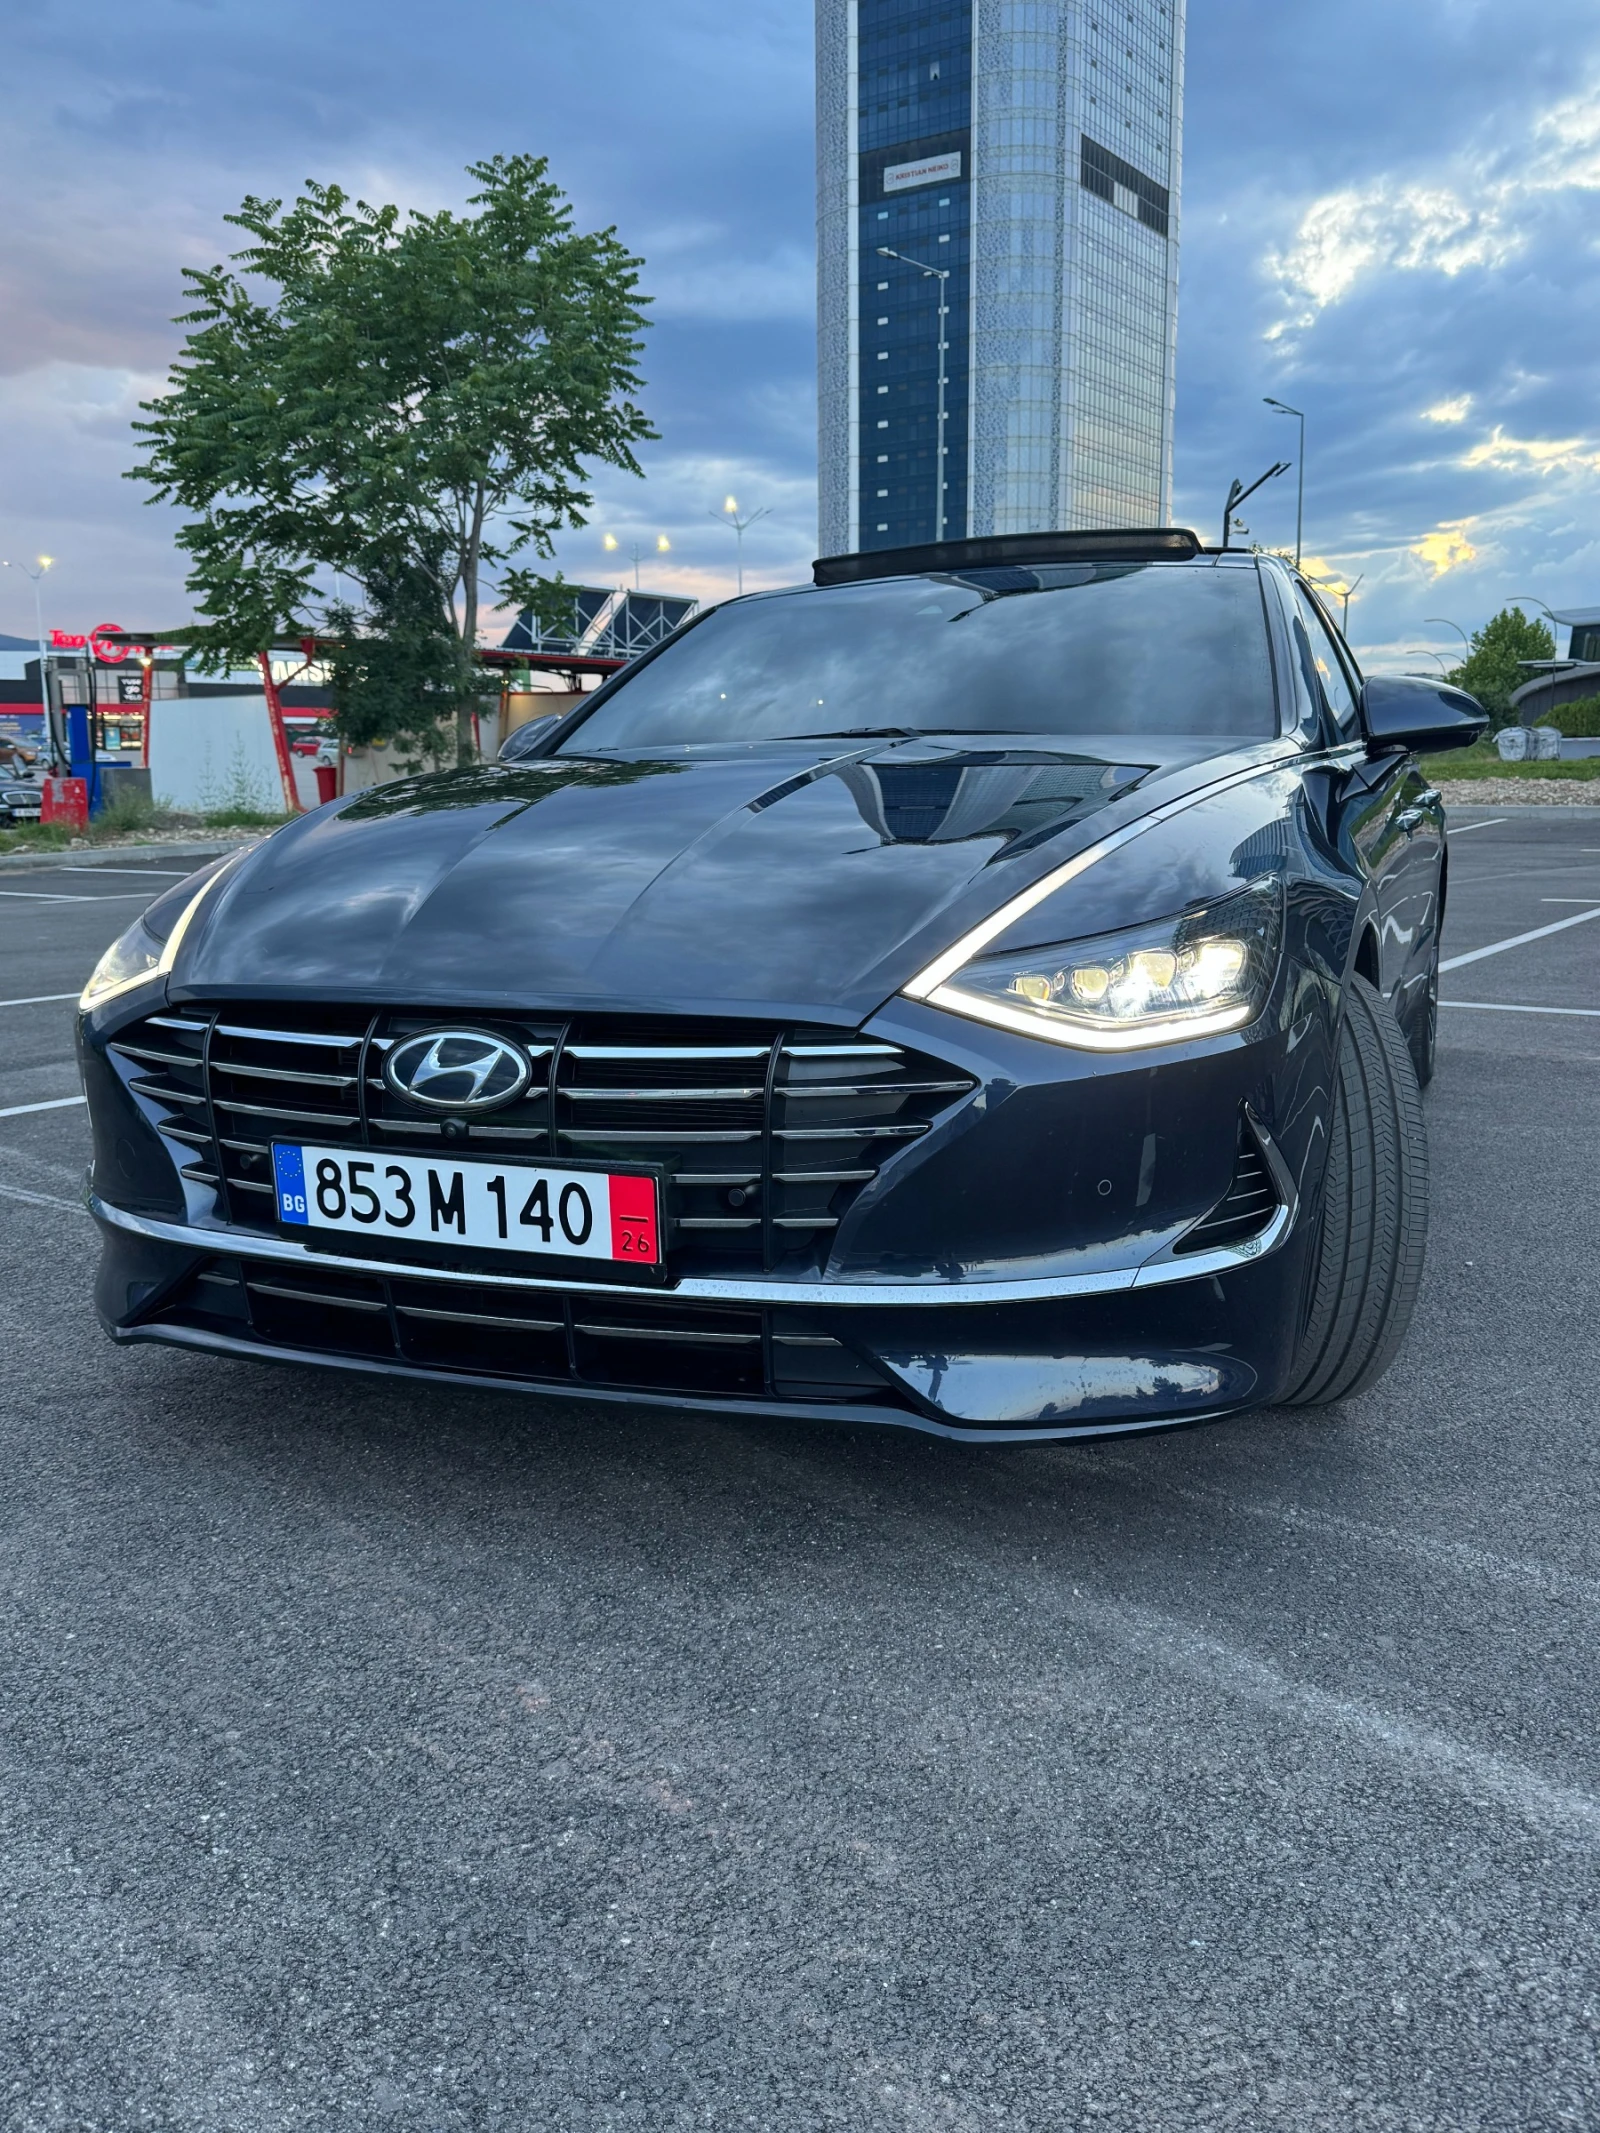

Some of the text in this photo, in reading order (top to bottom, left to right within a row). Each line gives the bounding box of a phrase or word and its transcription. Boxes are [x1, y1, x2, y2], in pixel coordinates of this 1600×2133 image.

[281, 1192, 306, 1213] BG
[315, 1158, 593, 1246] 853 M 140
[621, 1229, 651, 1253] 26
